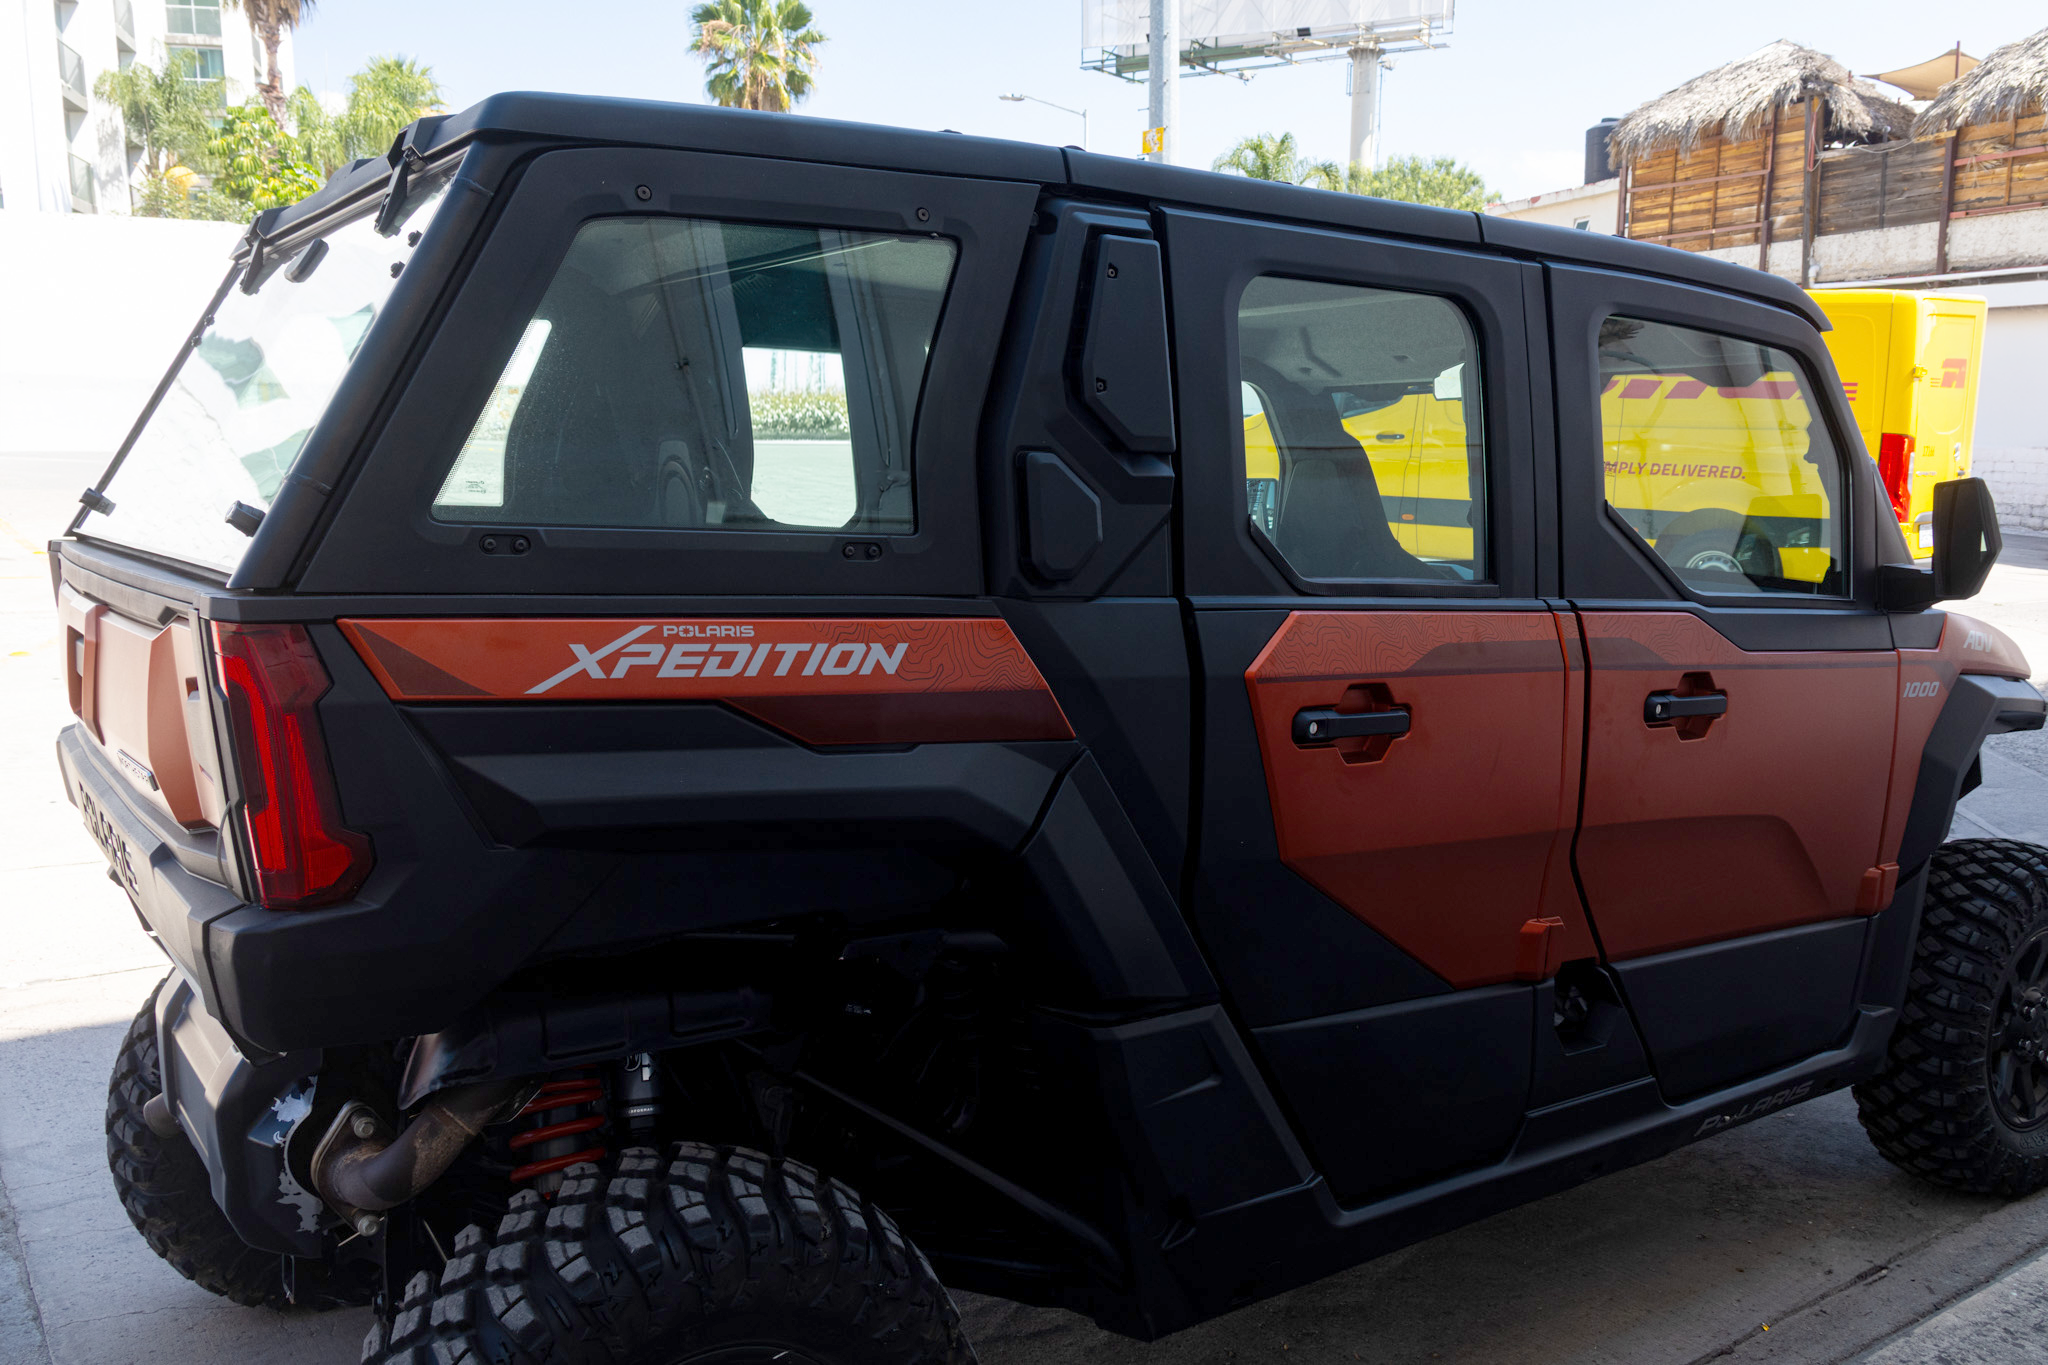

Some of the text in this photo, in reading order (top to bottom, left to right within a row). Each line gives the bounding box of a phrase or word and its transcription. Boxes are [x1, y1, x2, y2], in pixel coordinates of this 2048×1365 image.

[1649, 463, 1746, 480] DELIVERED.
[662, 625, 755, 638] POLARIS
[1963, 630, 1993, 653] ADV
[523, 625, 909, 694] XPEDITION
[1903, 681, 1940, 698] 1000
